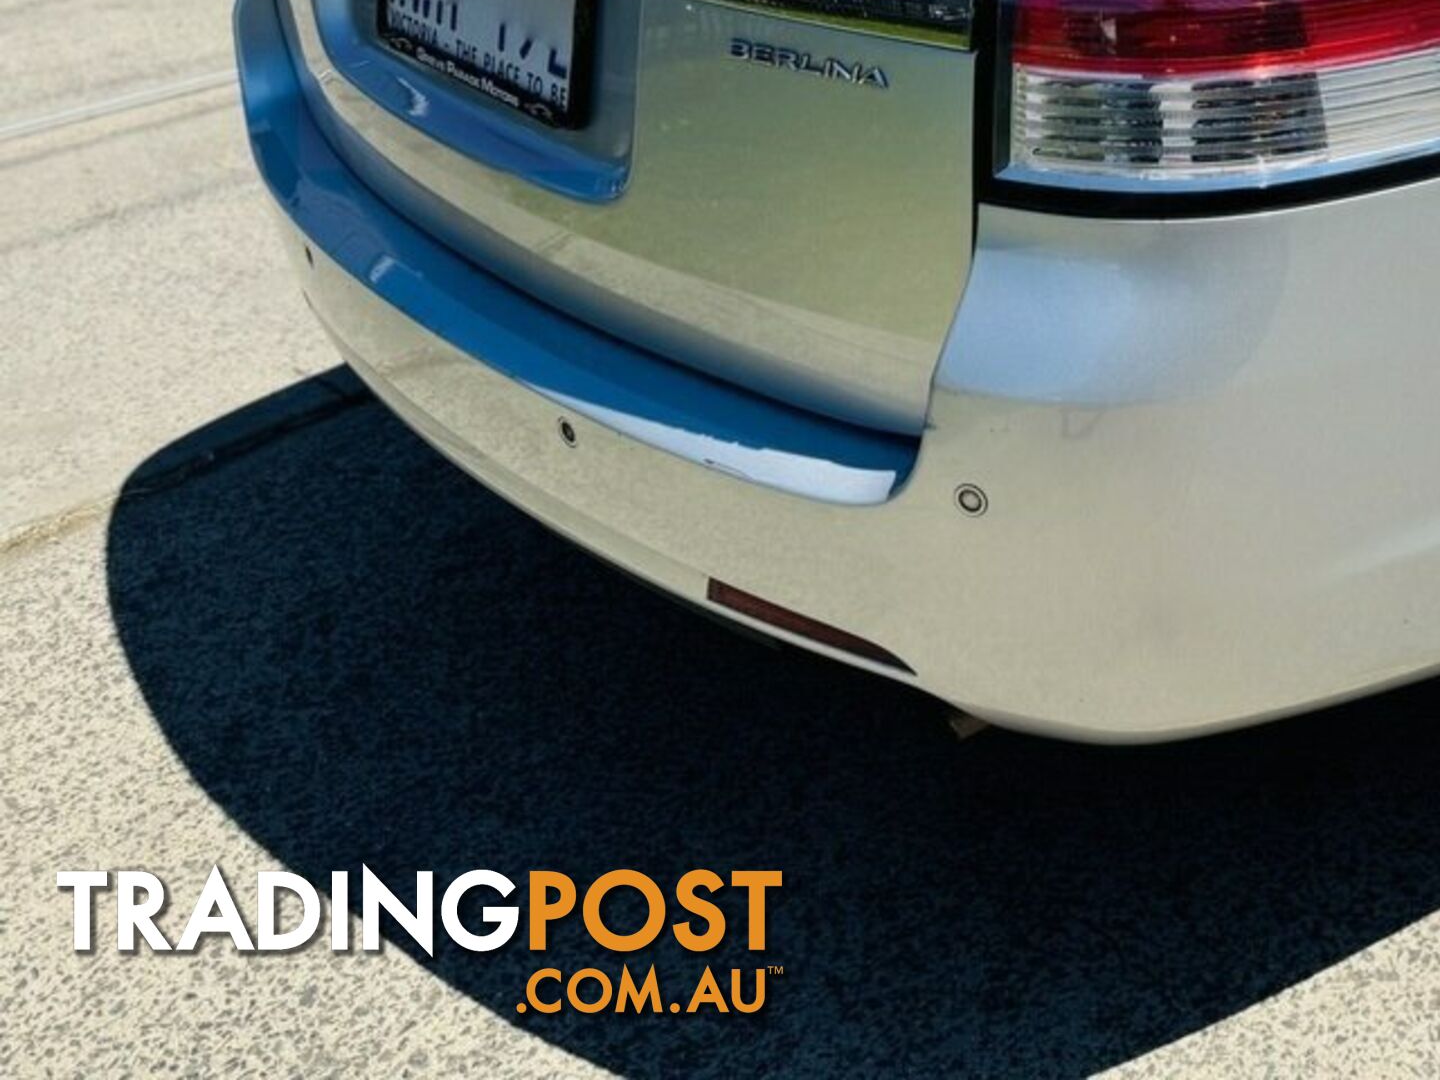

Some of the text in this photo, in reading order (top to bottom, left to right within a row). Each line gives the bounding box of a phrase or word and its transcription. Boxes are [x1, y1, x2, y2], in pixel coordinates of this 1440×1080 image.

[457, 38, 477, 62] THE
[483, 52, 520, 81] PLACE
[527, 71, 543, 95] TO
[551, 83, 567, 110] BE
[730, 37, 889, 88] BERLINA
